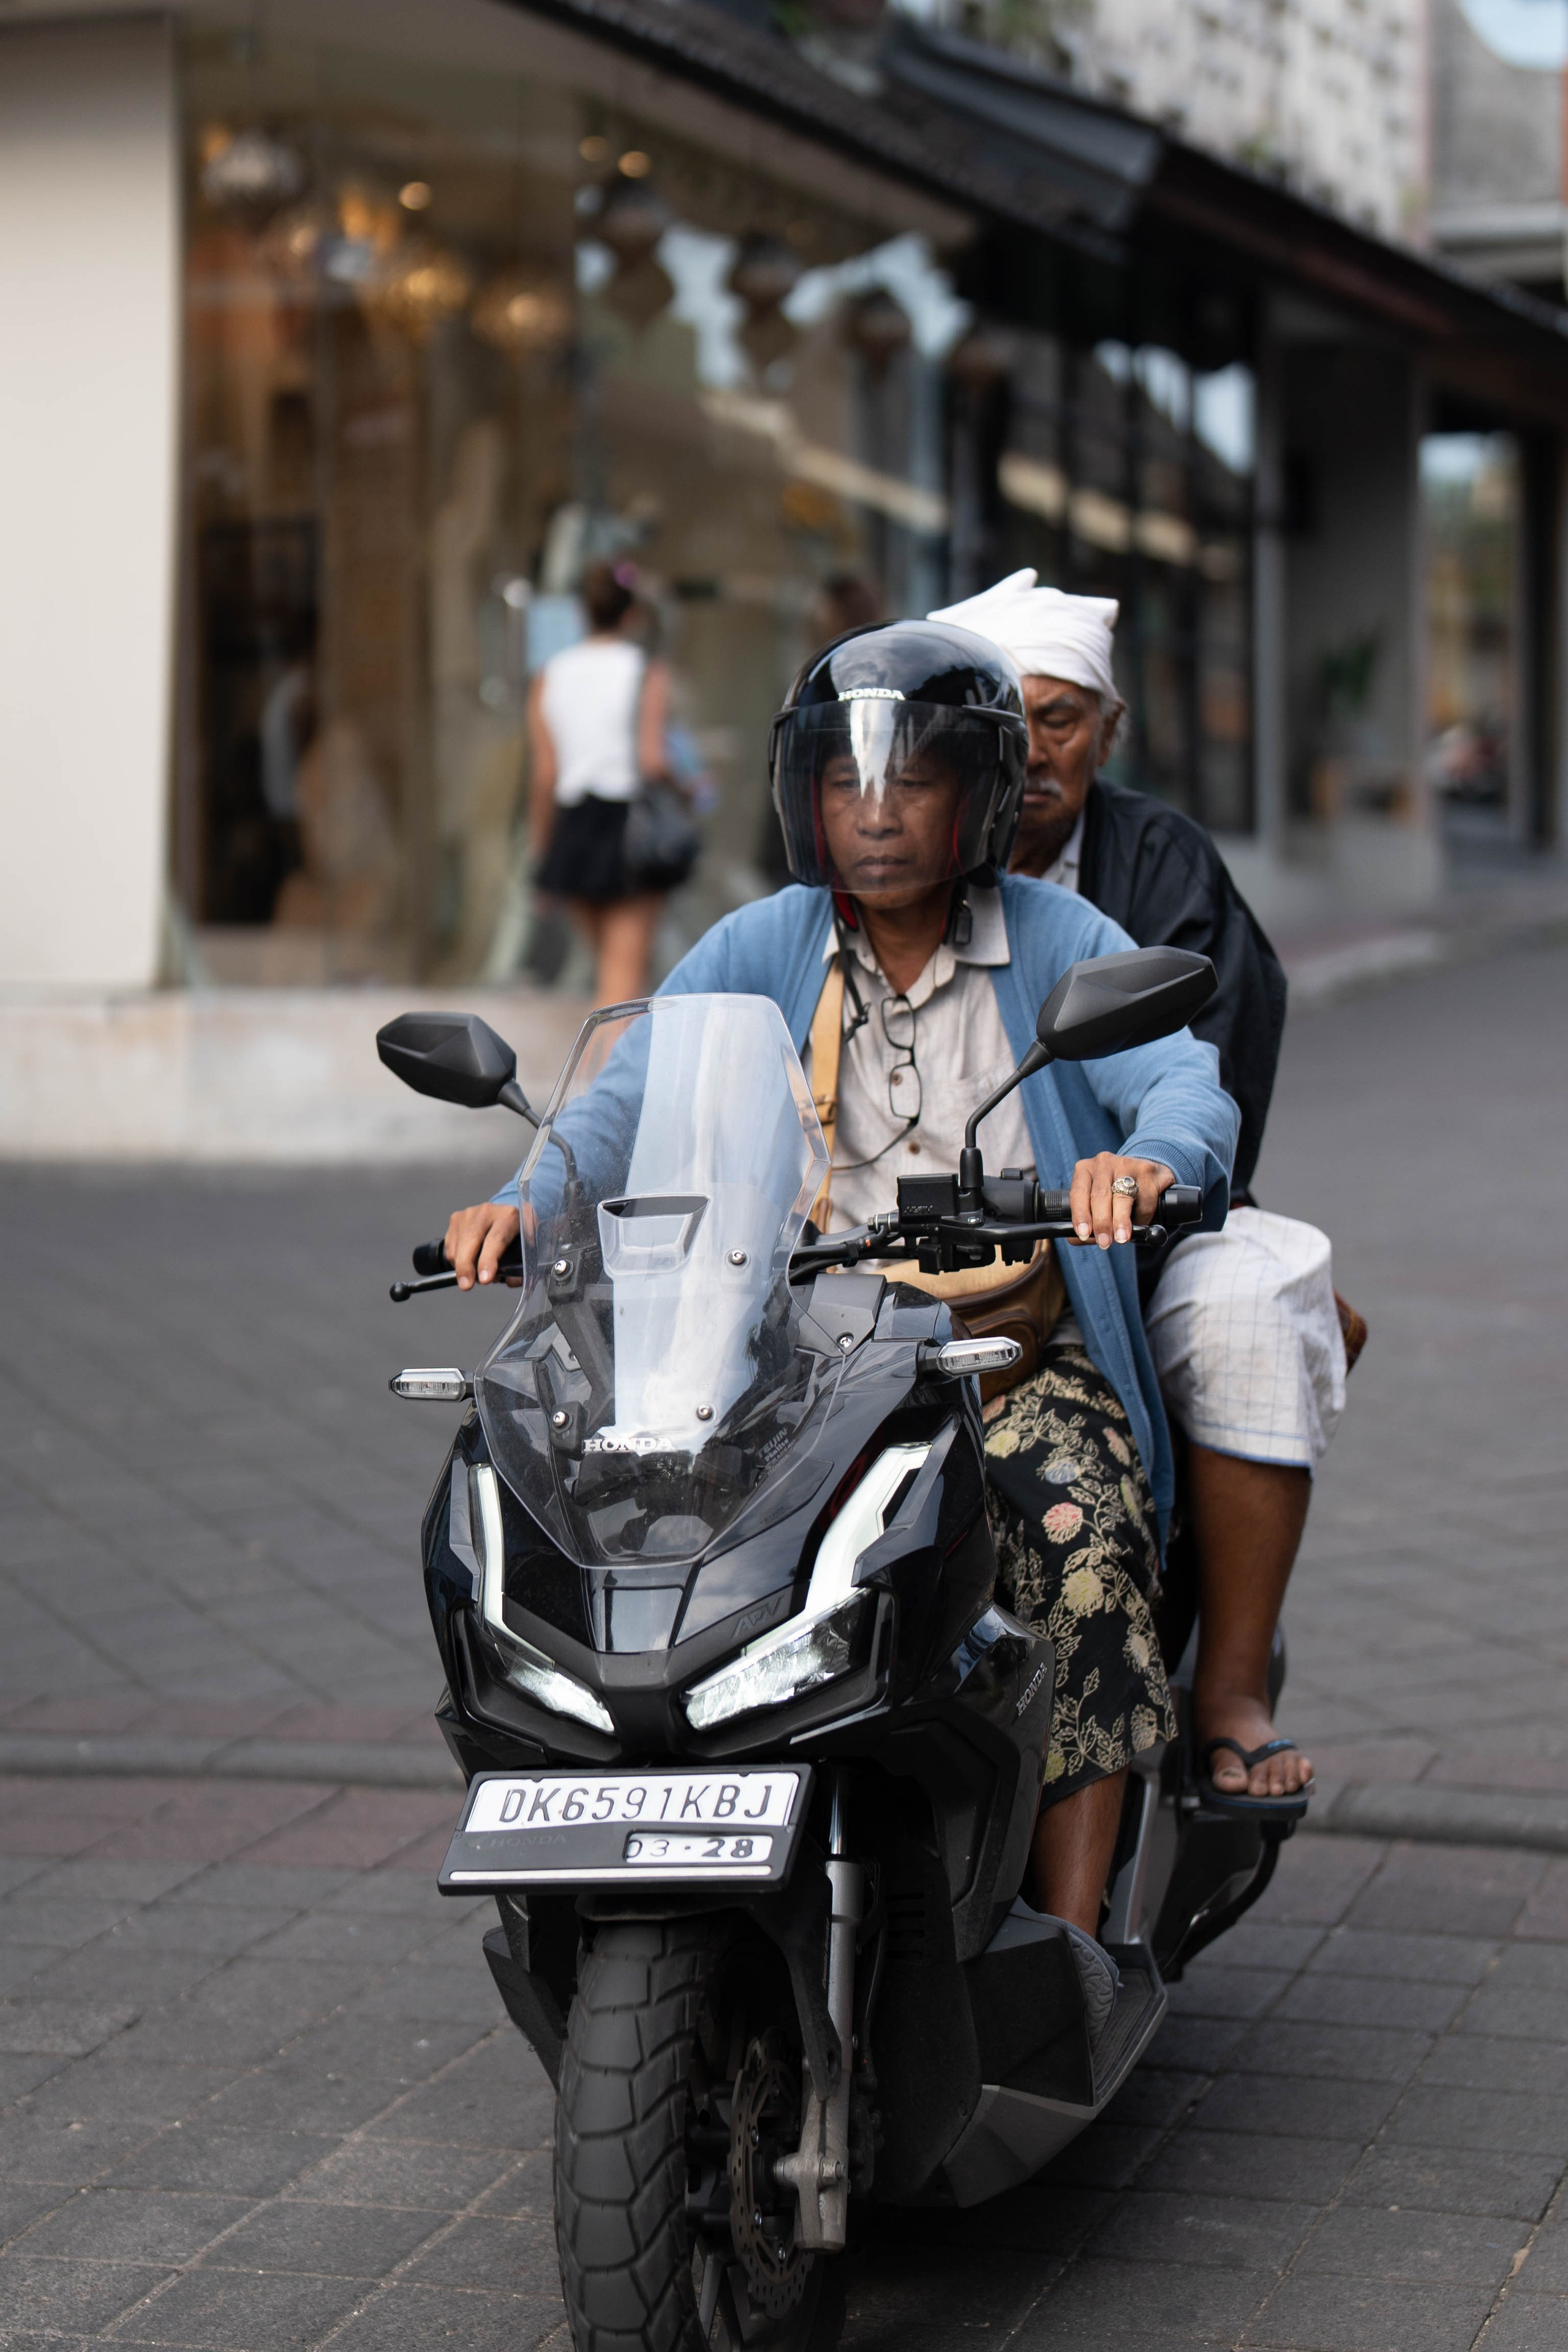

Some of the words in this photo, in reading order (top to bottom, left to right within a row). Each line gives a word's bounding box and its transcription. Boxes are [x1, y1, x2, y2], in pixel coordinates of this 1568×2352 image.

[837, 687, 906, 701] HONDA
[582, 1437, 675, 1452] HONDA
[731, 1594, 785, 1640] ADV
[1016, 1662, 1047, 1717] HONDA
